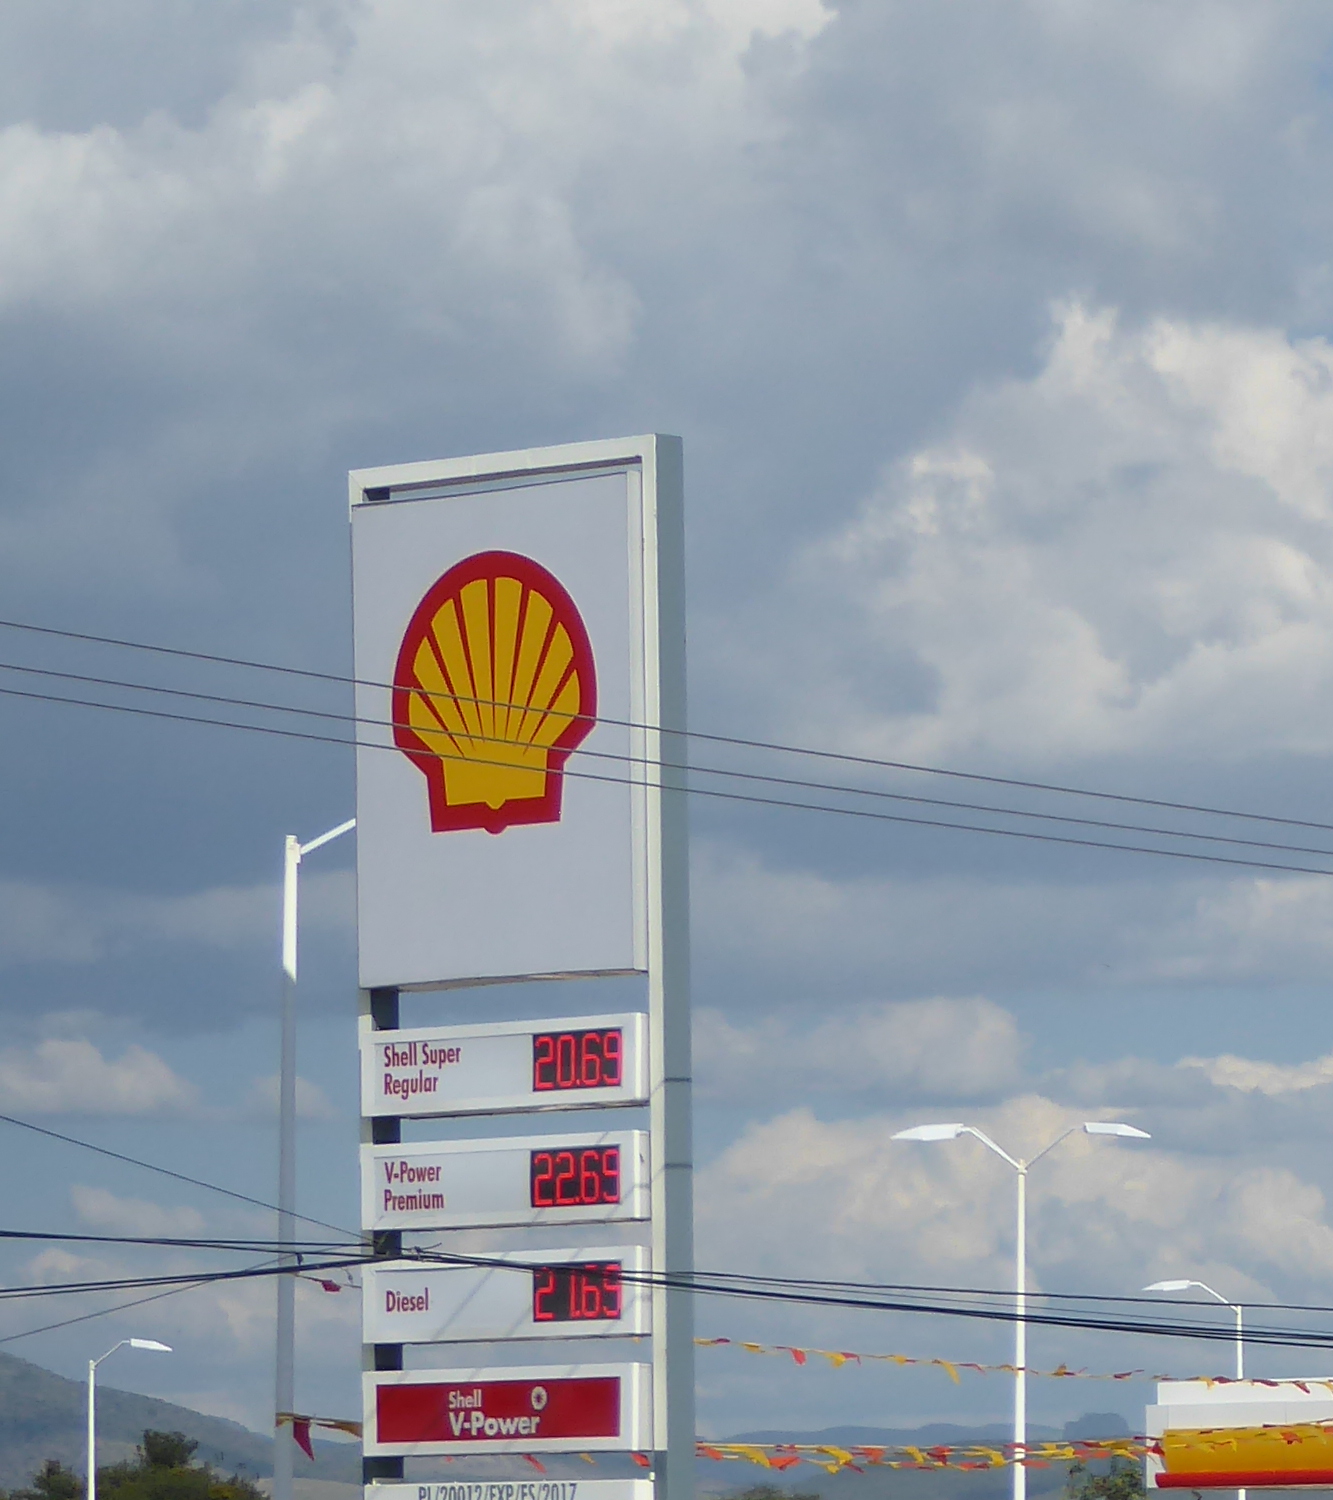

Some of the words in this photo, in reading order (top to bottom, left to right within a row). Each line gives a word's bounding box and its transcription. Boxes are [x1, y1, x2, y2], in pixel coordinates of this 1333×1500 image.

[383, 1041, 418, 1068] Shell
[421, 1042, 462, 1070] Super
[535, 1031, 622, 1089] 20.69
[383, 1069, 439, 1100] Regular
[384, 1161, 442, 1184] V-Power
[534, 1149, 620, 1206] 22.69
[383, 1188, 445, 1212] Premium
[385, 1287, 429, 1313] Diesel
[448, 1388, 482, 1410] Shell
[449, 1411, 540, 1436] V-Power
